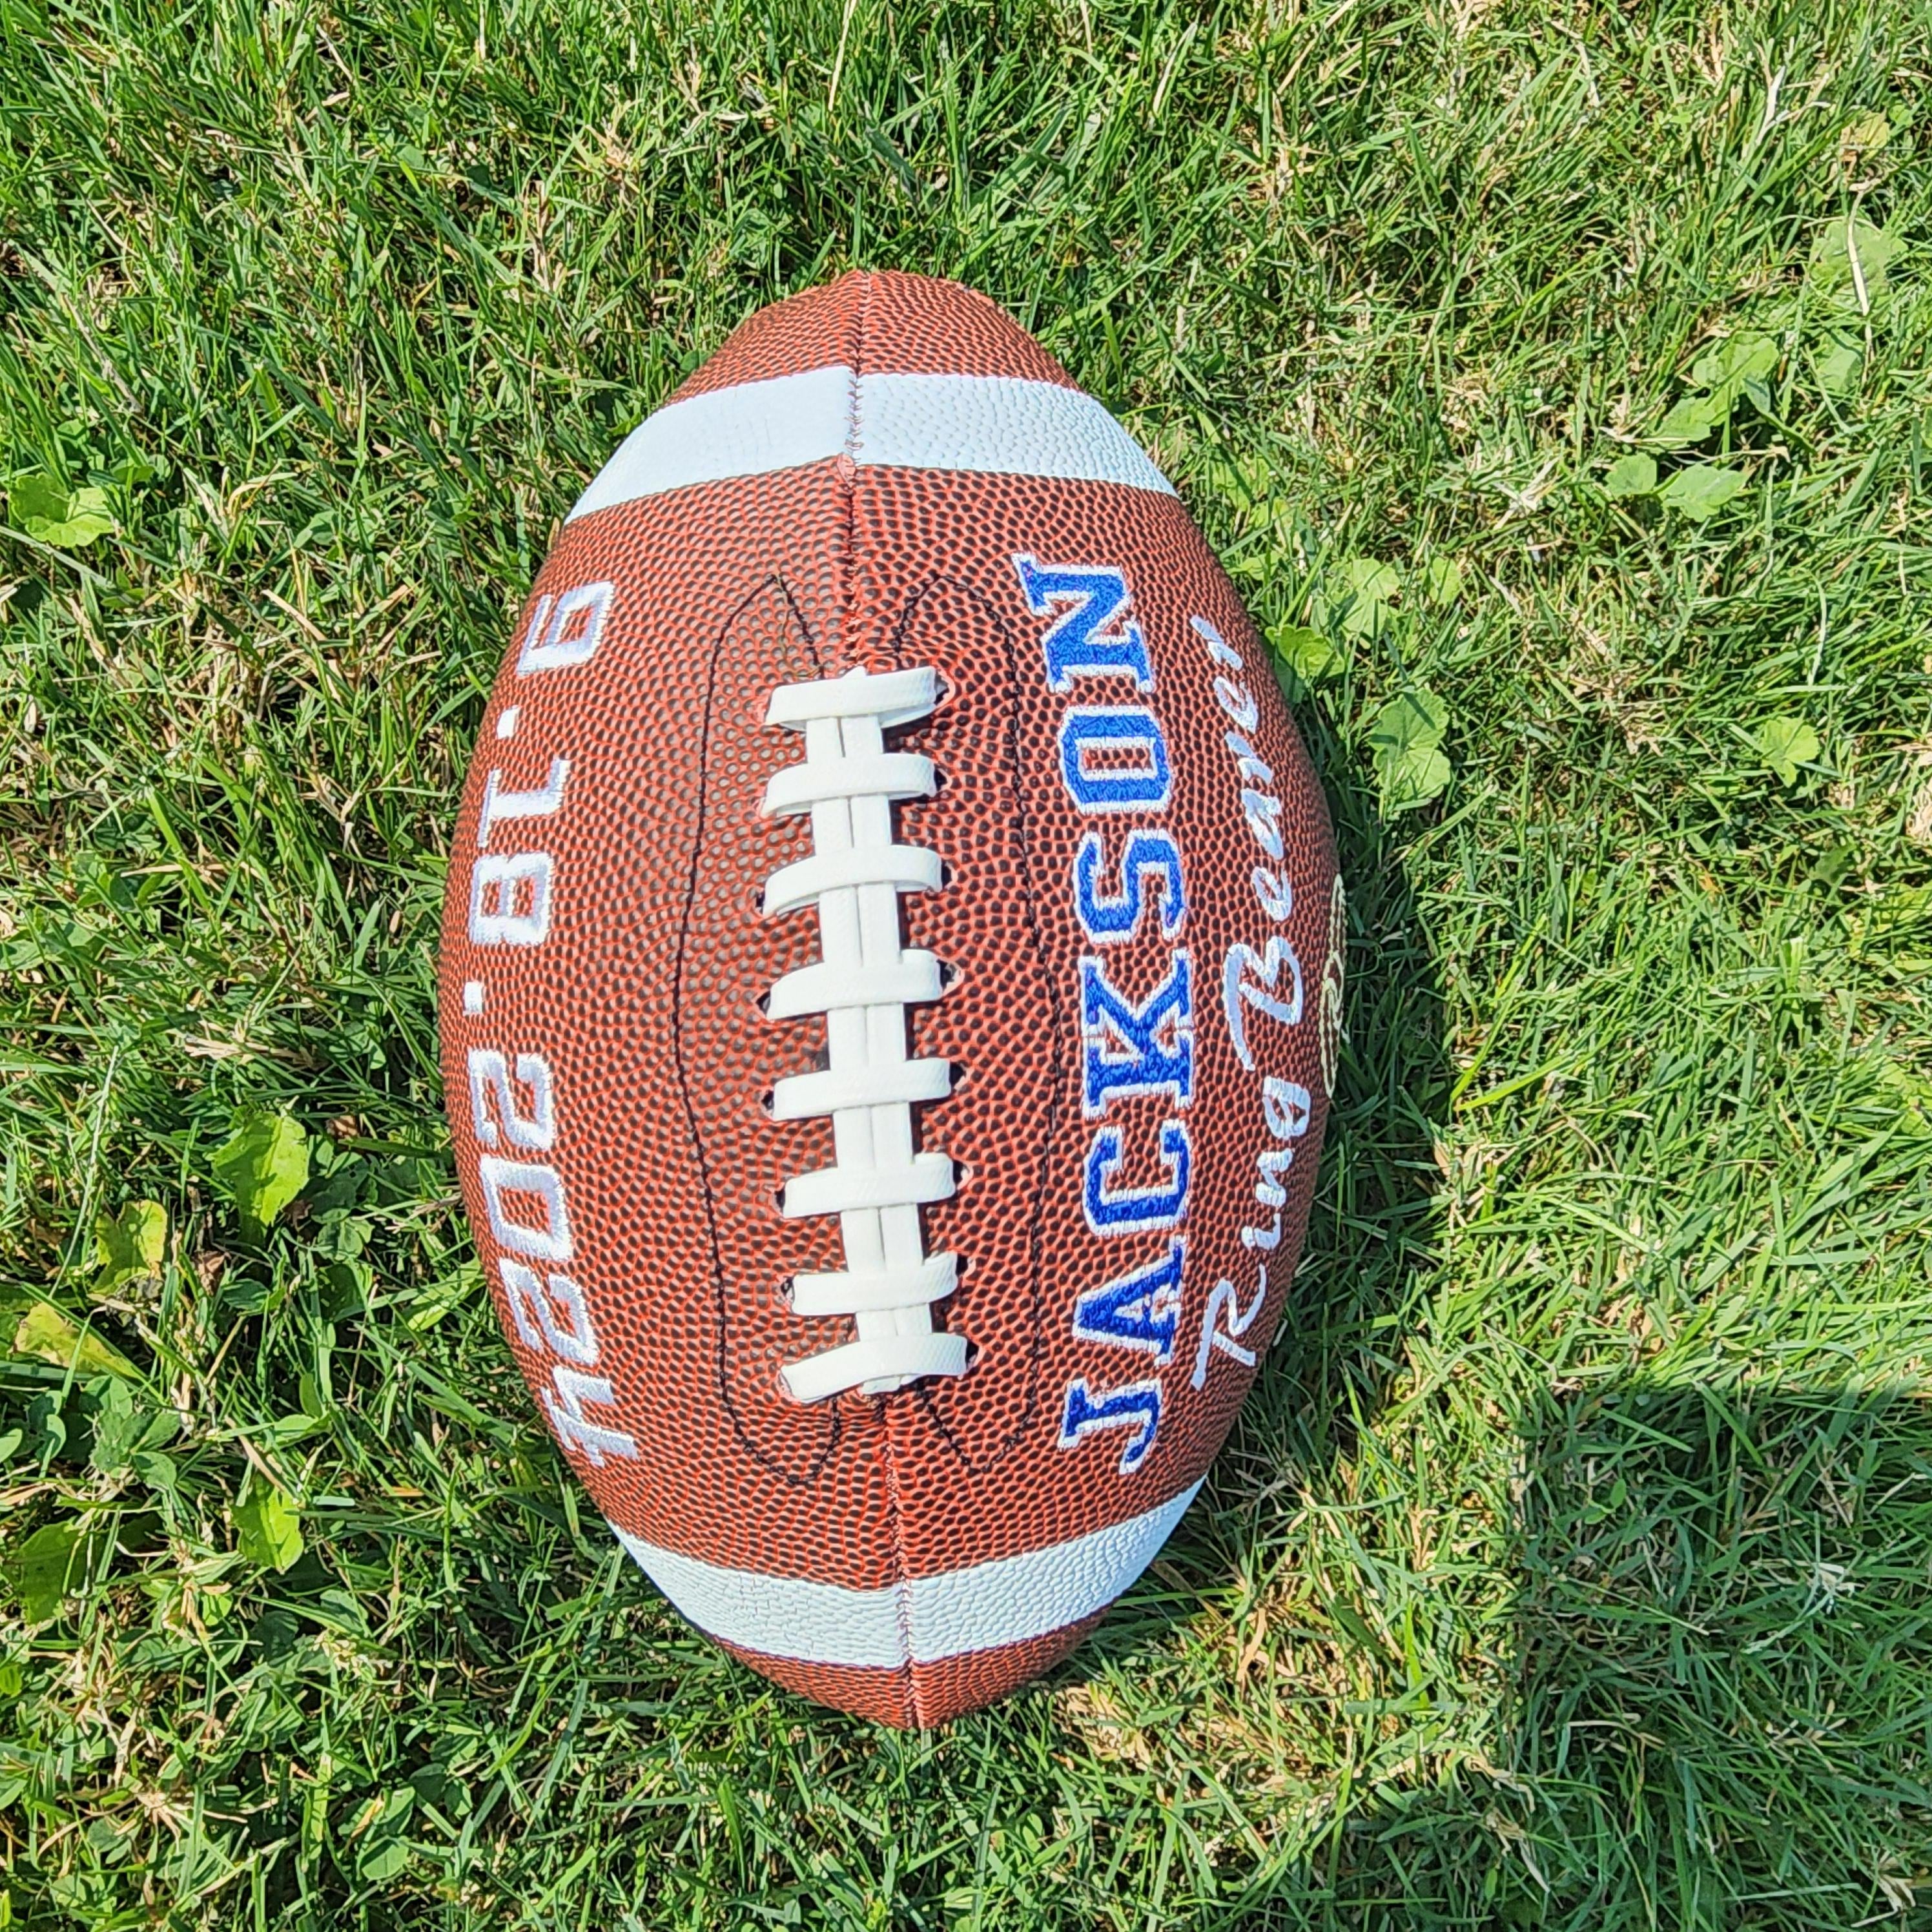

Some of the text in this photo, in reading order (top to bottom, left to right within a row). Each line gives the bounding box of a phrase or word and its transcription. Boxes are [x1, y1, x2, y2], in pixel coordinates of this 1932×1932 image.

[464, 581, 641, 1468] 9.18.2024
[1011, 551, 1195, 1475] JACKSON
[1189, 614, 1312, 1390] Ring Beaver
